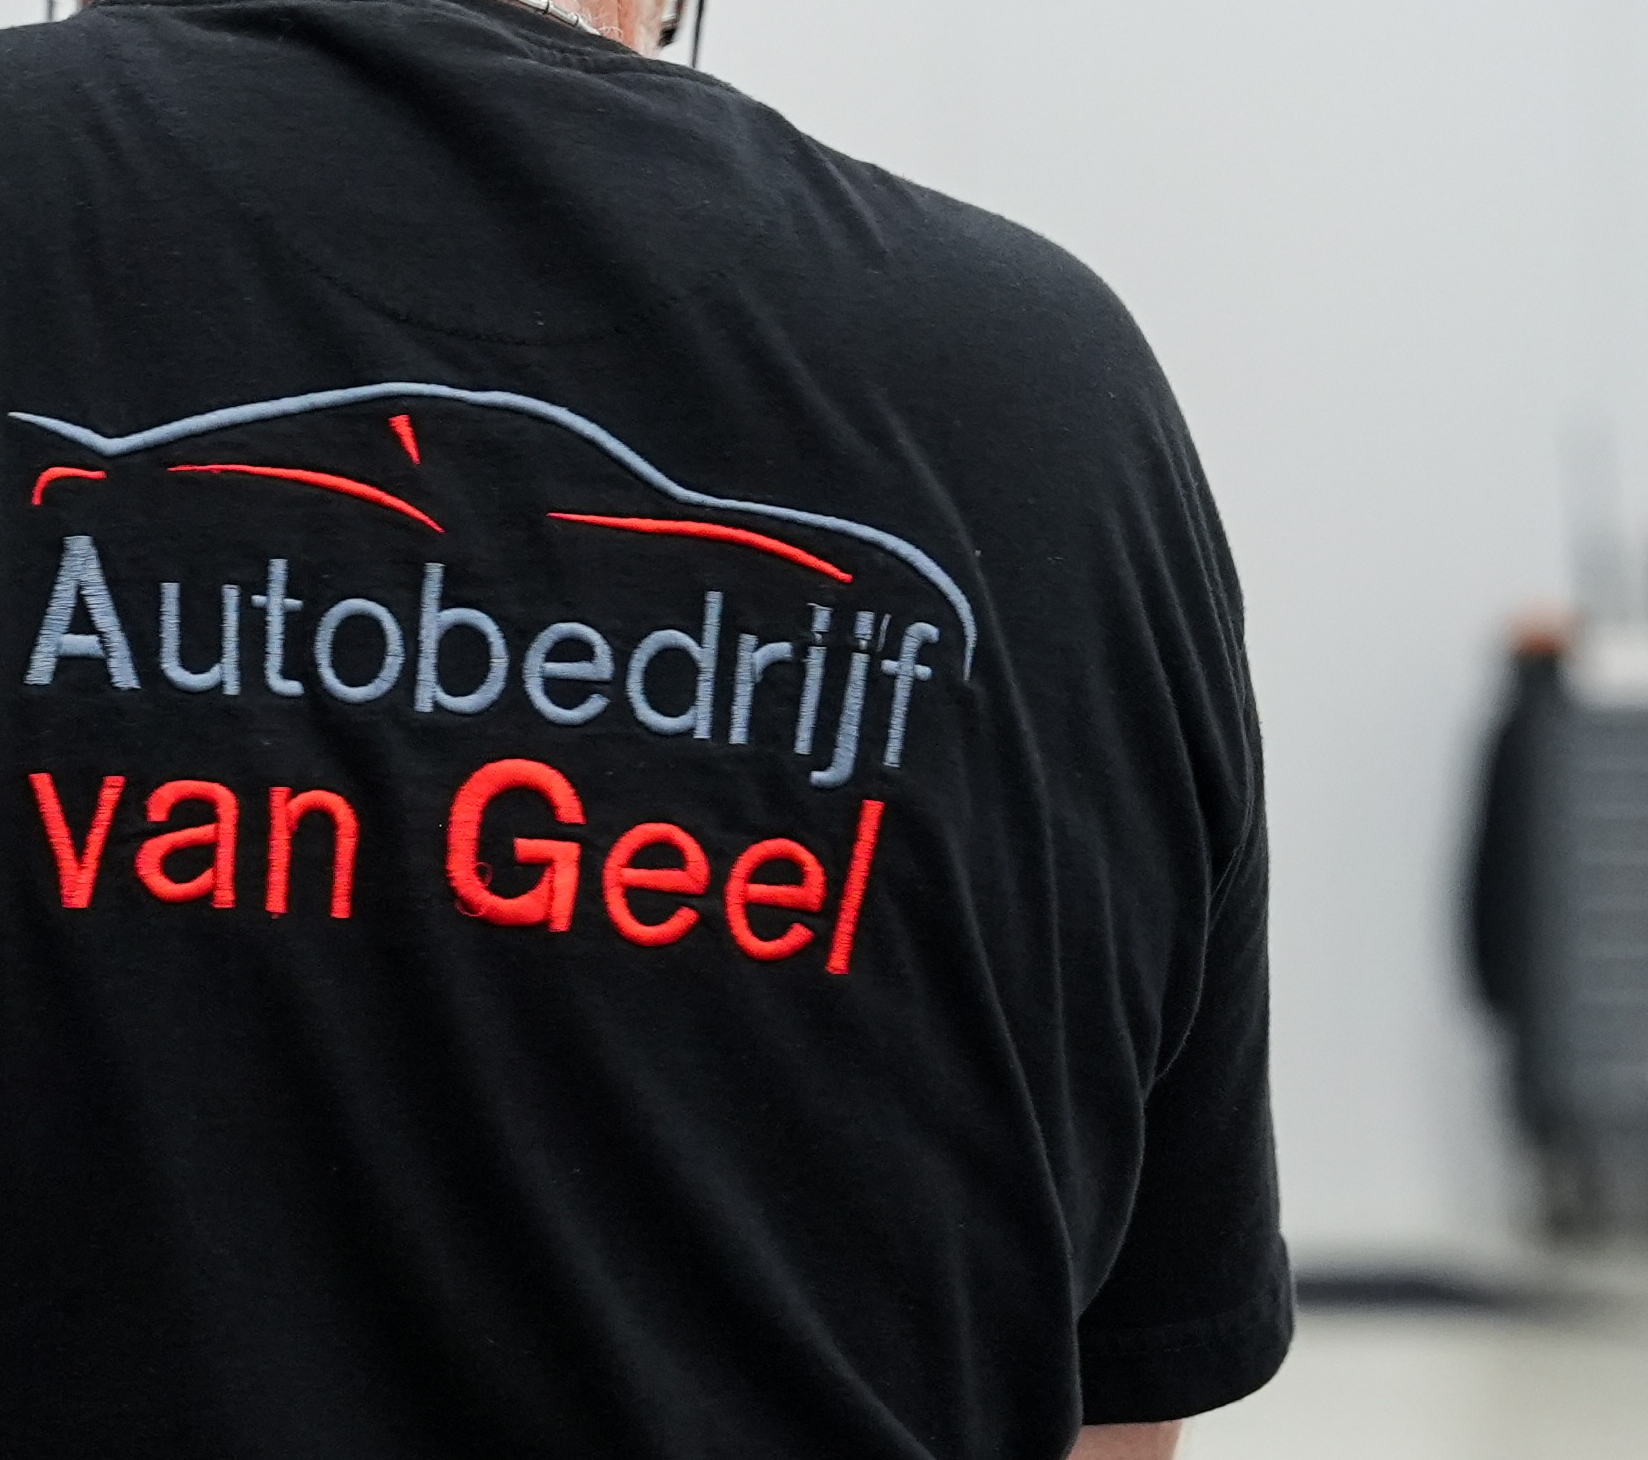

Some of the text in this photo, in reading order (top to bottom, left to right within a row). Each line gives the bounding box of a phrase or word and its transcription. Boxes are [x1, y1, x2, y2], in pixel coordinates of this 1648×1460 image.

[23, 534, 942, 788] Autobedrijf
[28, 757, 886, 976] van Geel
